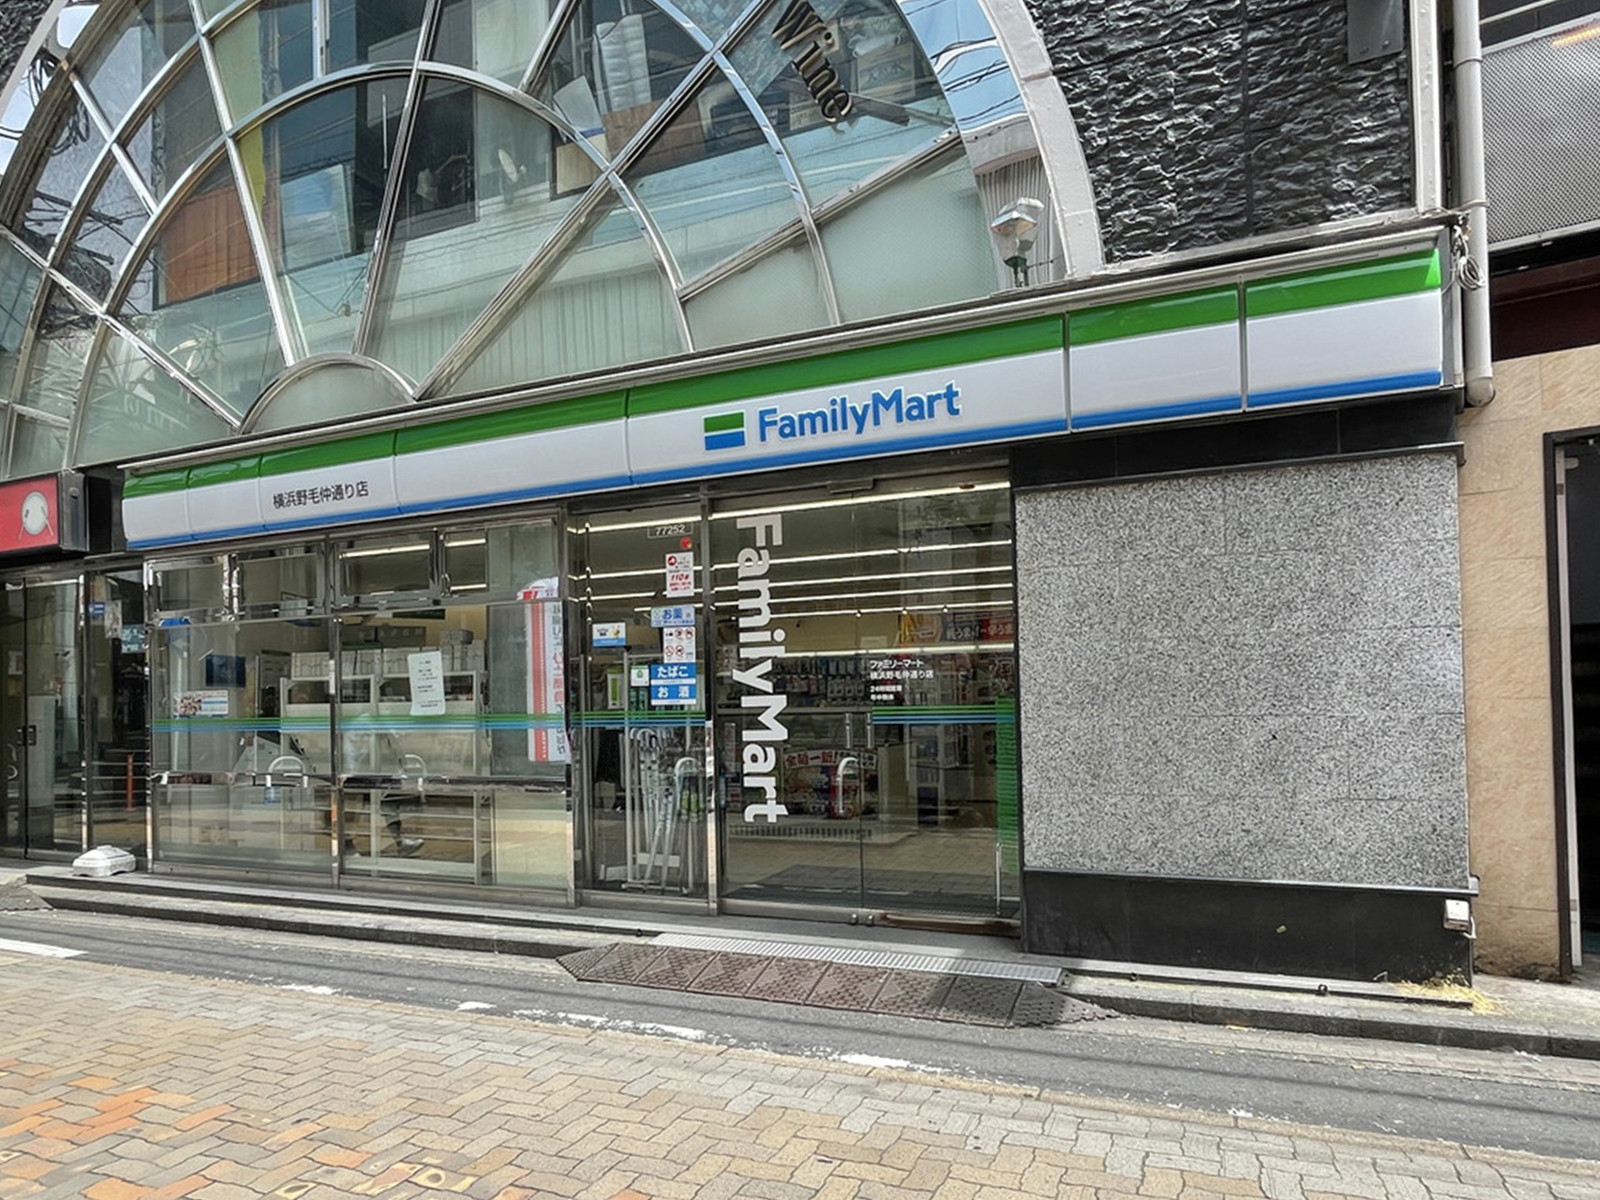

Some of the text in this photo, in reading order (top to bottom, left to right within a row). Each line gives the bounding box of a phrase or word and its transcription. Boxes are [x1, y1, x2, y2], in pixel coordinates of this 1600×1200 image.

[758, 382, 961, 442] FamilyMart
[273, 481, 369, 509] 横浜野毛仲通り店
[657, 665, 689, 679] たばこ
[732, 513, 789, 823] FamilyMart
[870, 659, 924, 669] ファミリーマート
